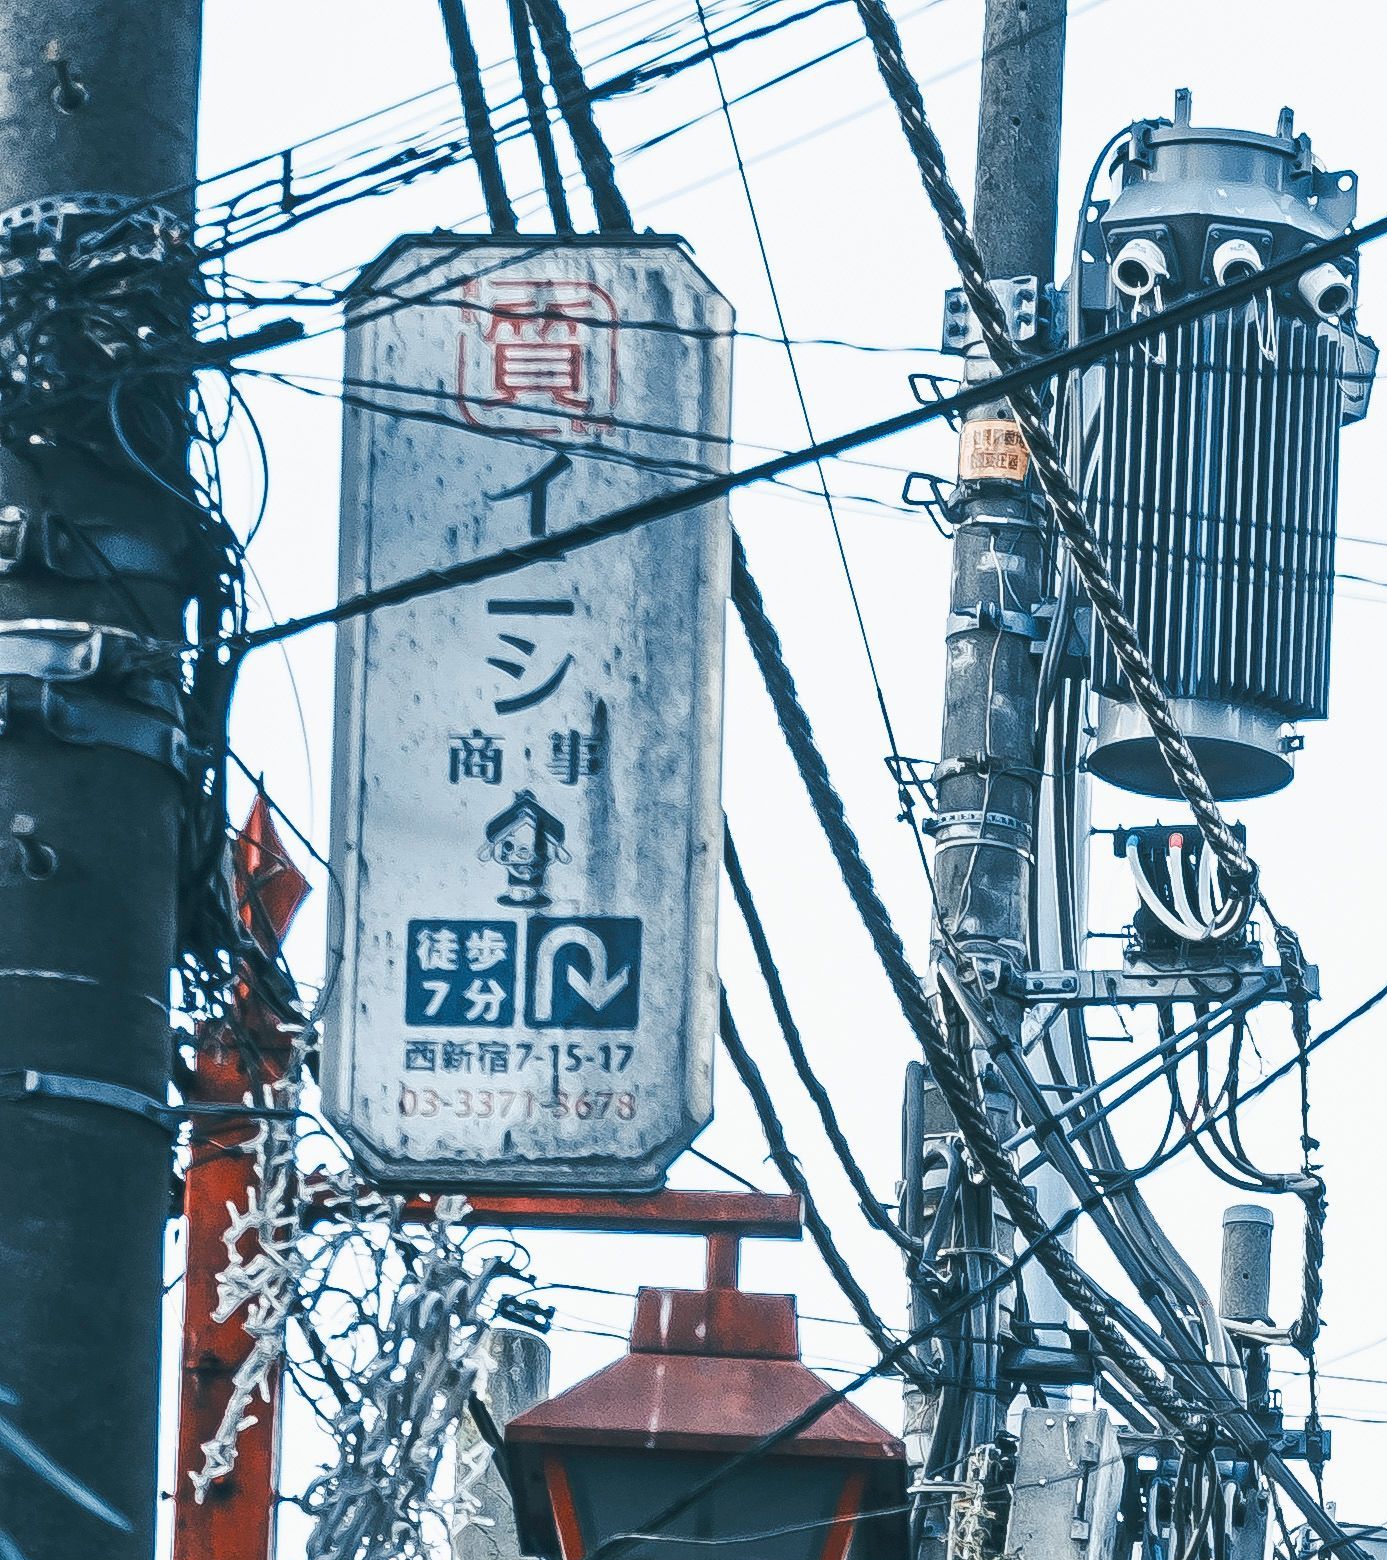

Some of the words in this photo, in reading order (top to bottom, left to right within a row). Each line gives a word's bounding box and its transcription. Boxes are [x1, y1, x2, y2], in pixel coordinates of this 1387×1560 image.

[487, 300, 596, 410] 質
[448, 729, 603, 785] 商事
[416, 929, 508, 972] 徒歩
[422, 980, 508, 1022] 7分
[403, 1040, 636, 1074] 西新宿7-15-17
[400, 1088, 638, 1121] 03-3371-3678
